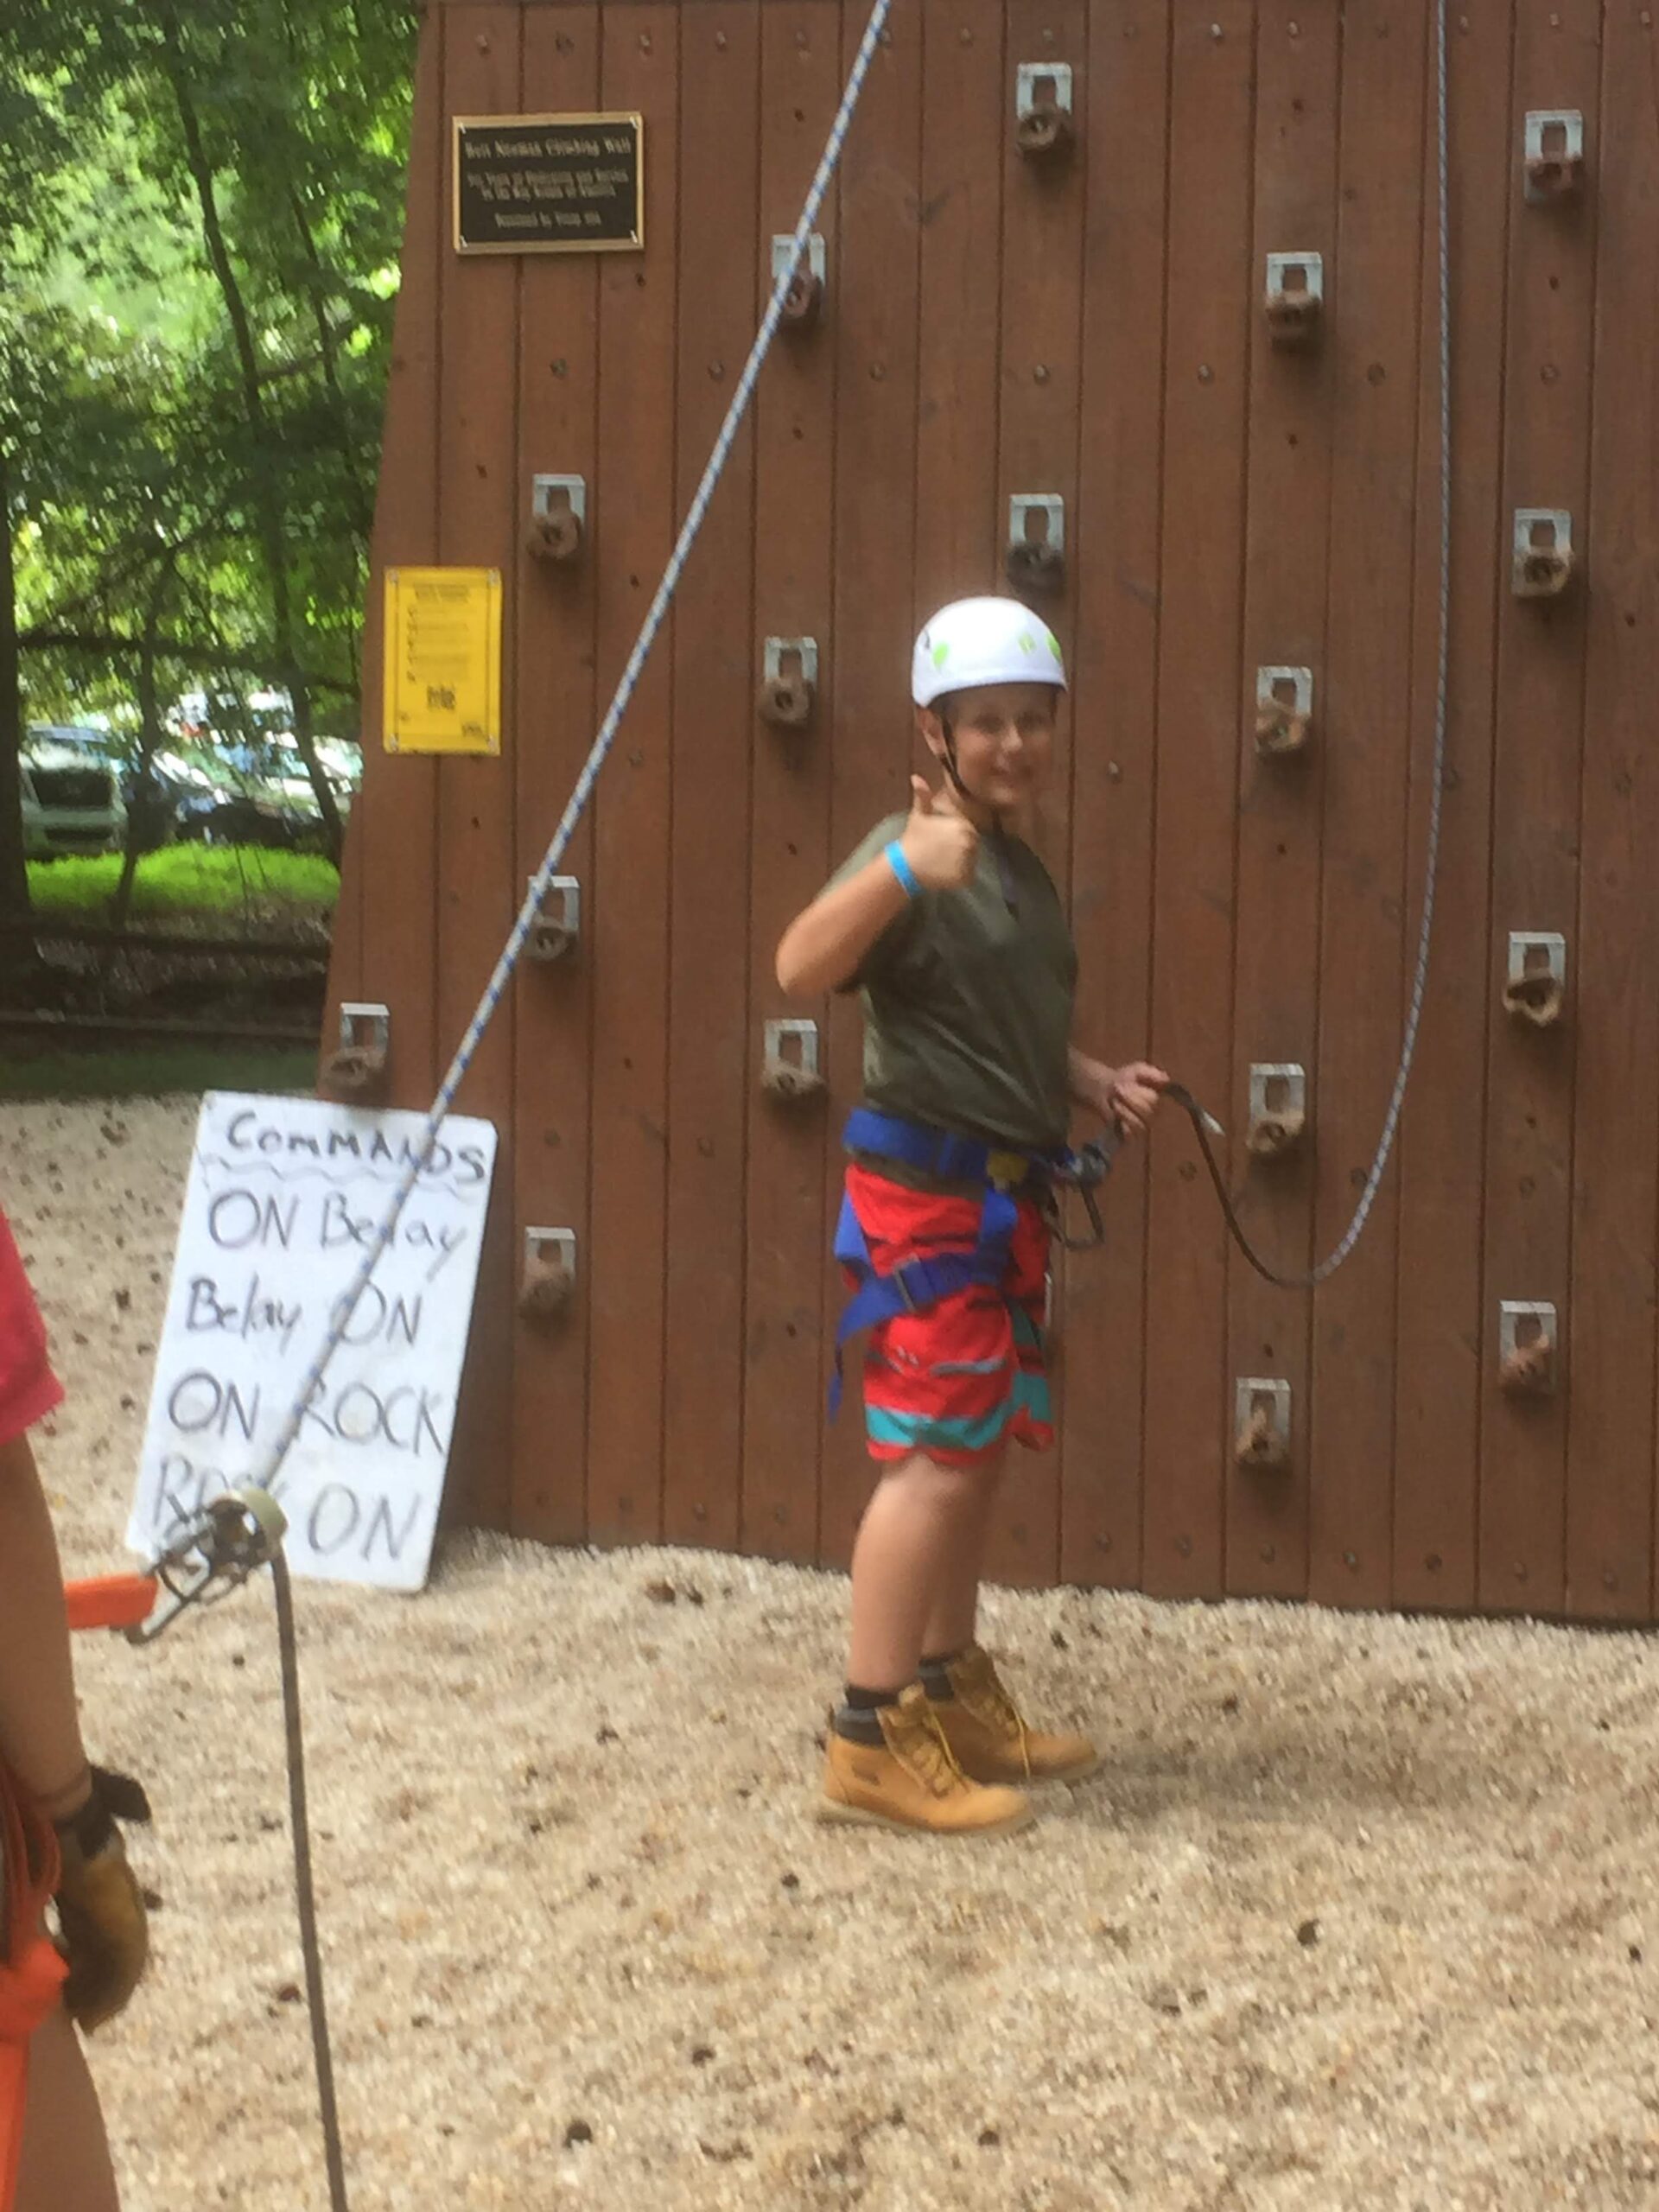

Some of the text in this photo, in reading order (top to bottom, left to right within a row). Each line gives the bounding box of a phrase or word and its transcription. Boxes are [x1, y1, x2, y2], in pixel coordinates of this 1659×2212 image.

[208, 1187, 299, 1250] ON
[186, 1273, 422, 1354] Belay ON
[167, 1369, 258, 1440] ON
[307, 1484, 420, 1562] ON
